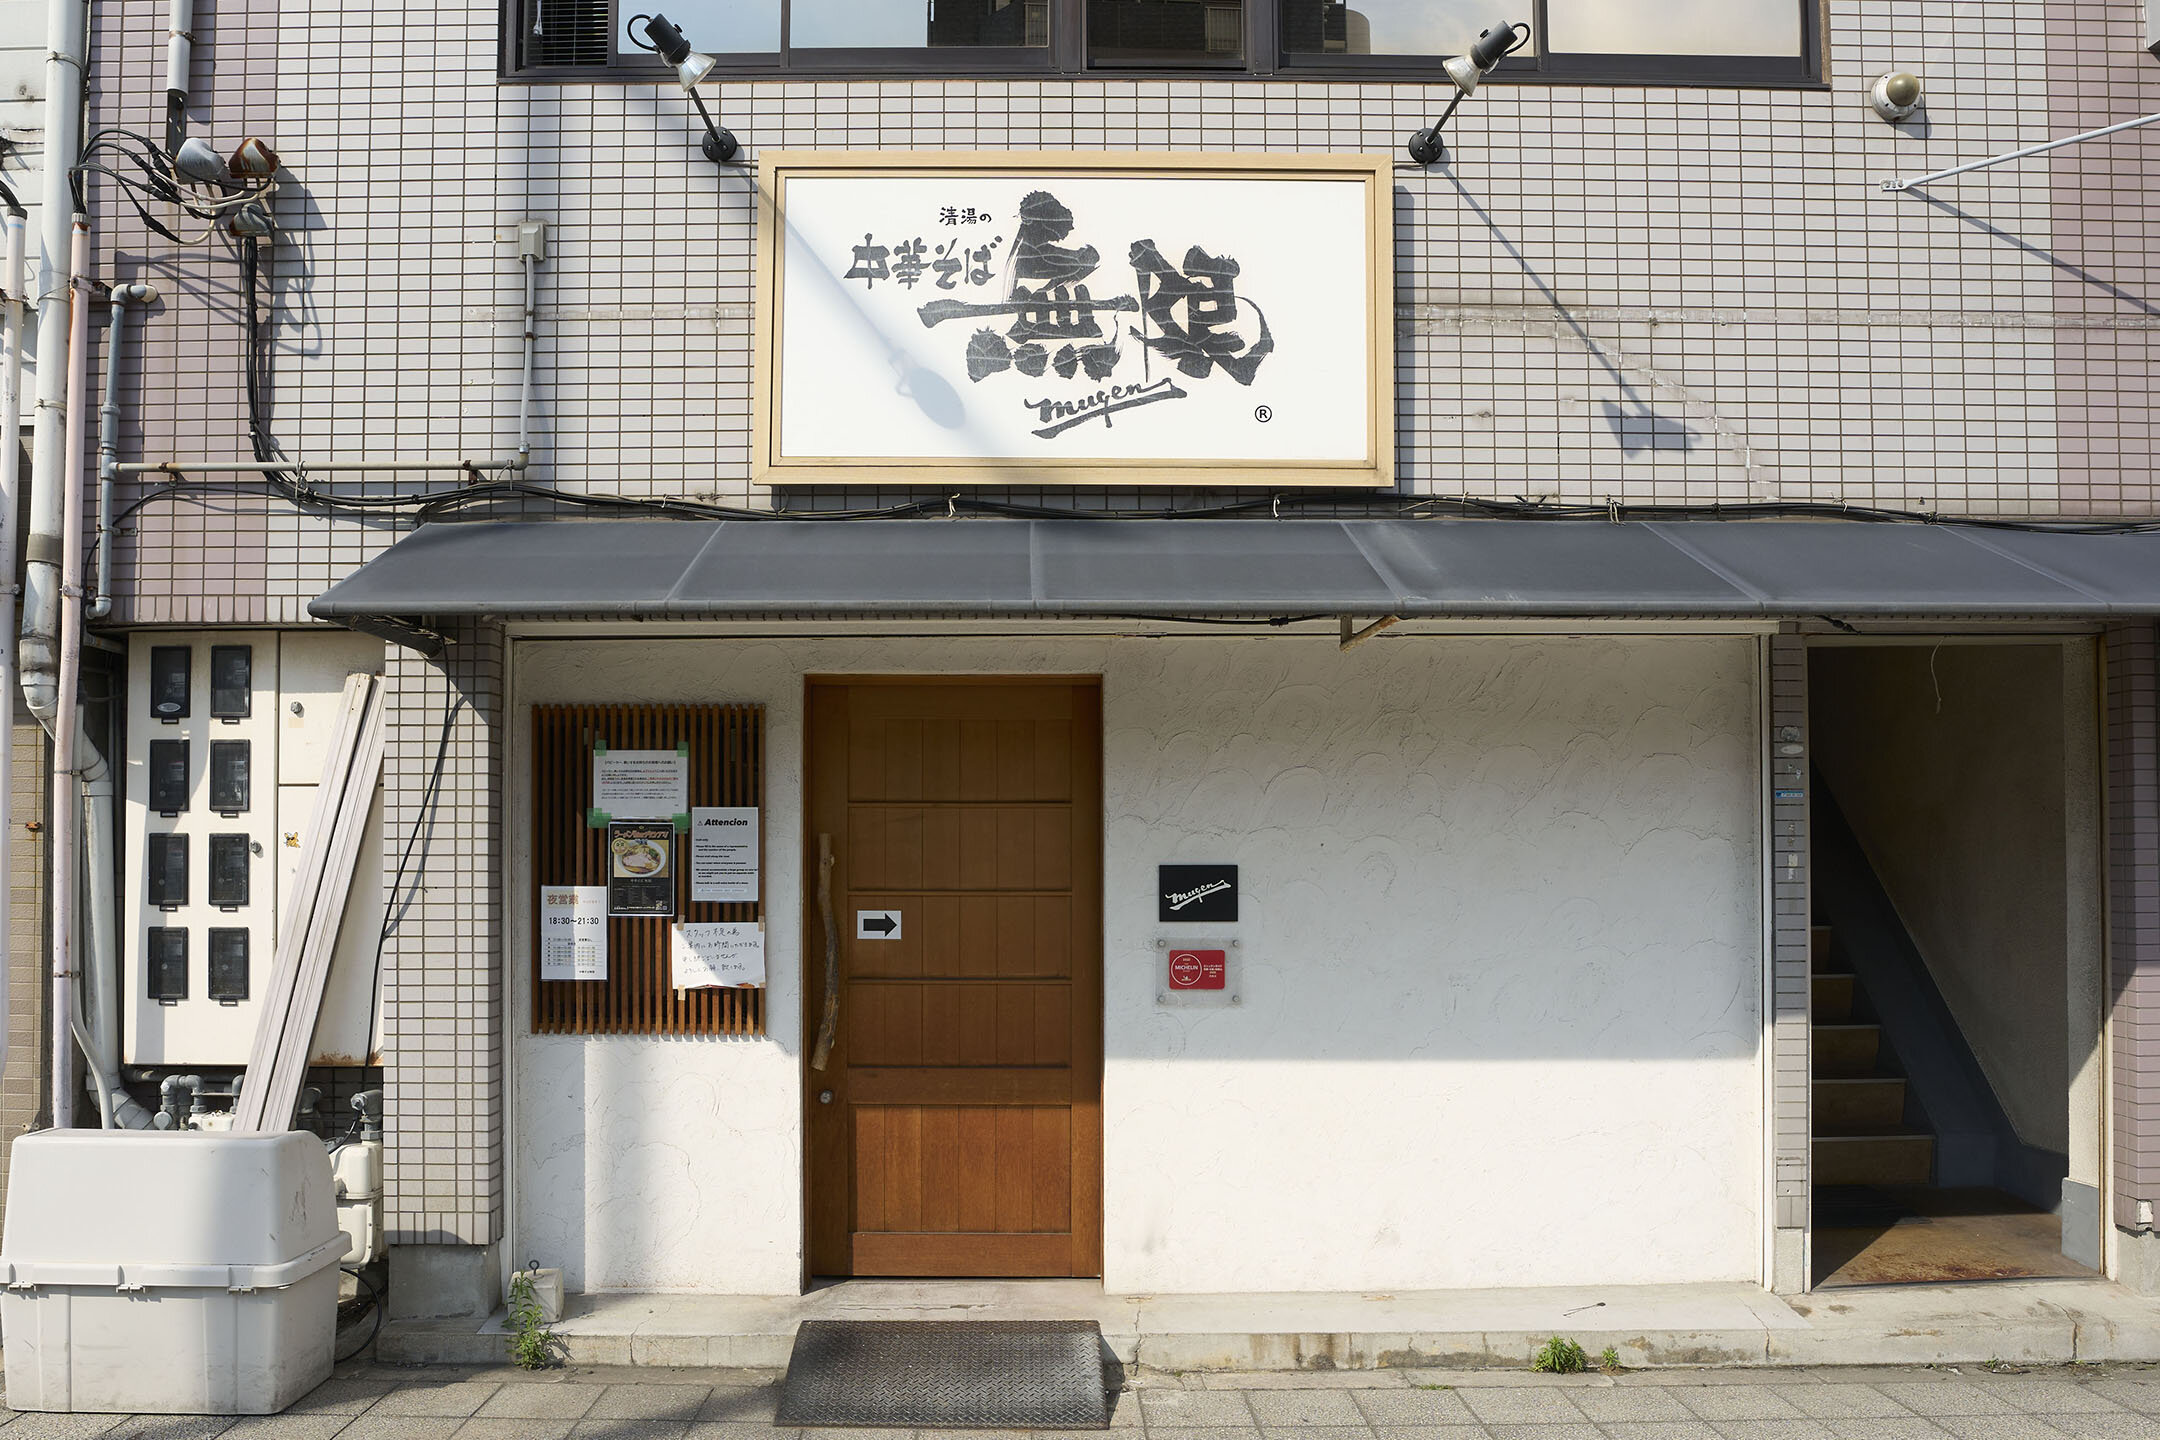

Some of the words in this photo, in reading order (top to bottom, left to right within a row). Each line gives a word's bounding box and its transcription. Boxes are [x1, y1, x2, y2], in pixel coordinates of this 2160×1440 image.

[939, 206, 992, 226] 清湯の
[843, 232, 1003, 290] 中華そば
[916, 190, 1275, 387] 無限
[1024, 378, 1187, 439] mugen
[704, 818, 748, 827] Attencion
[547, 893, 579, 905] 夜営業
[1165, 880, 1231, 910] mugen
